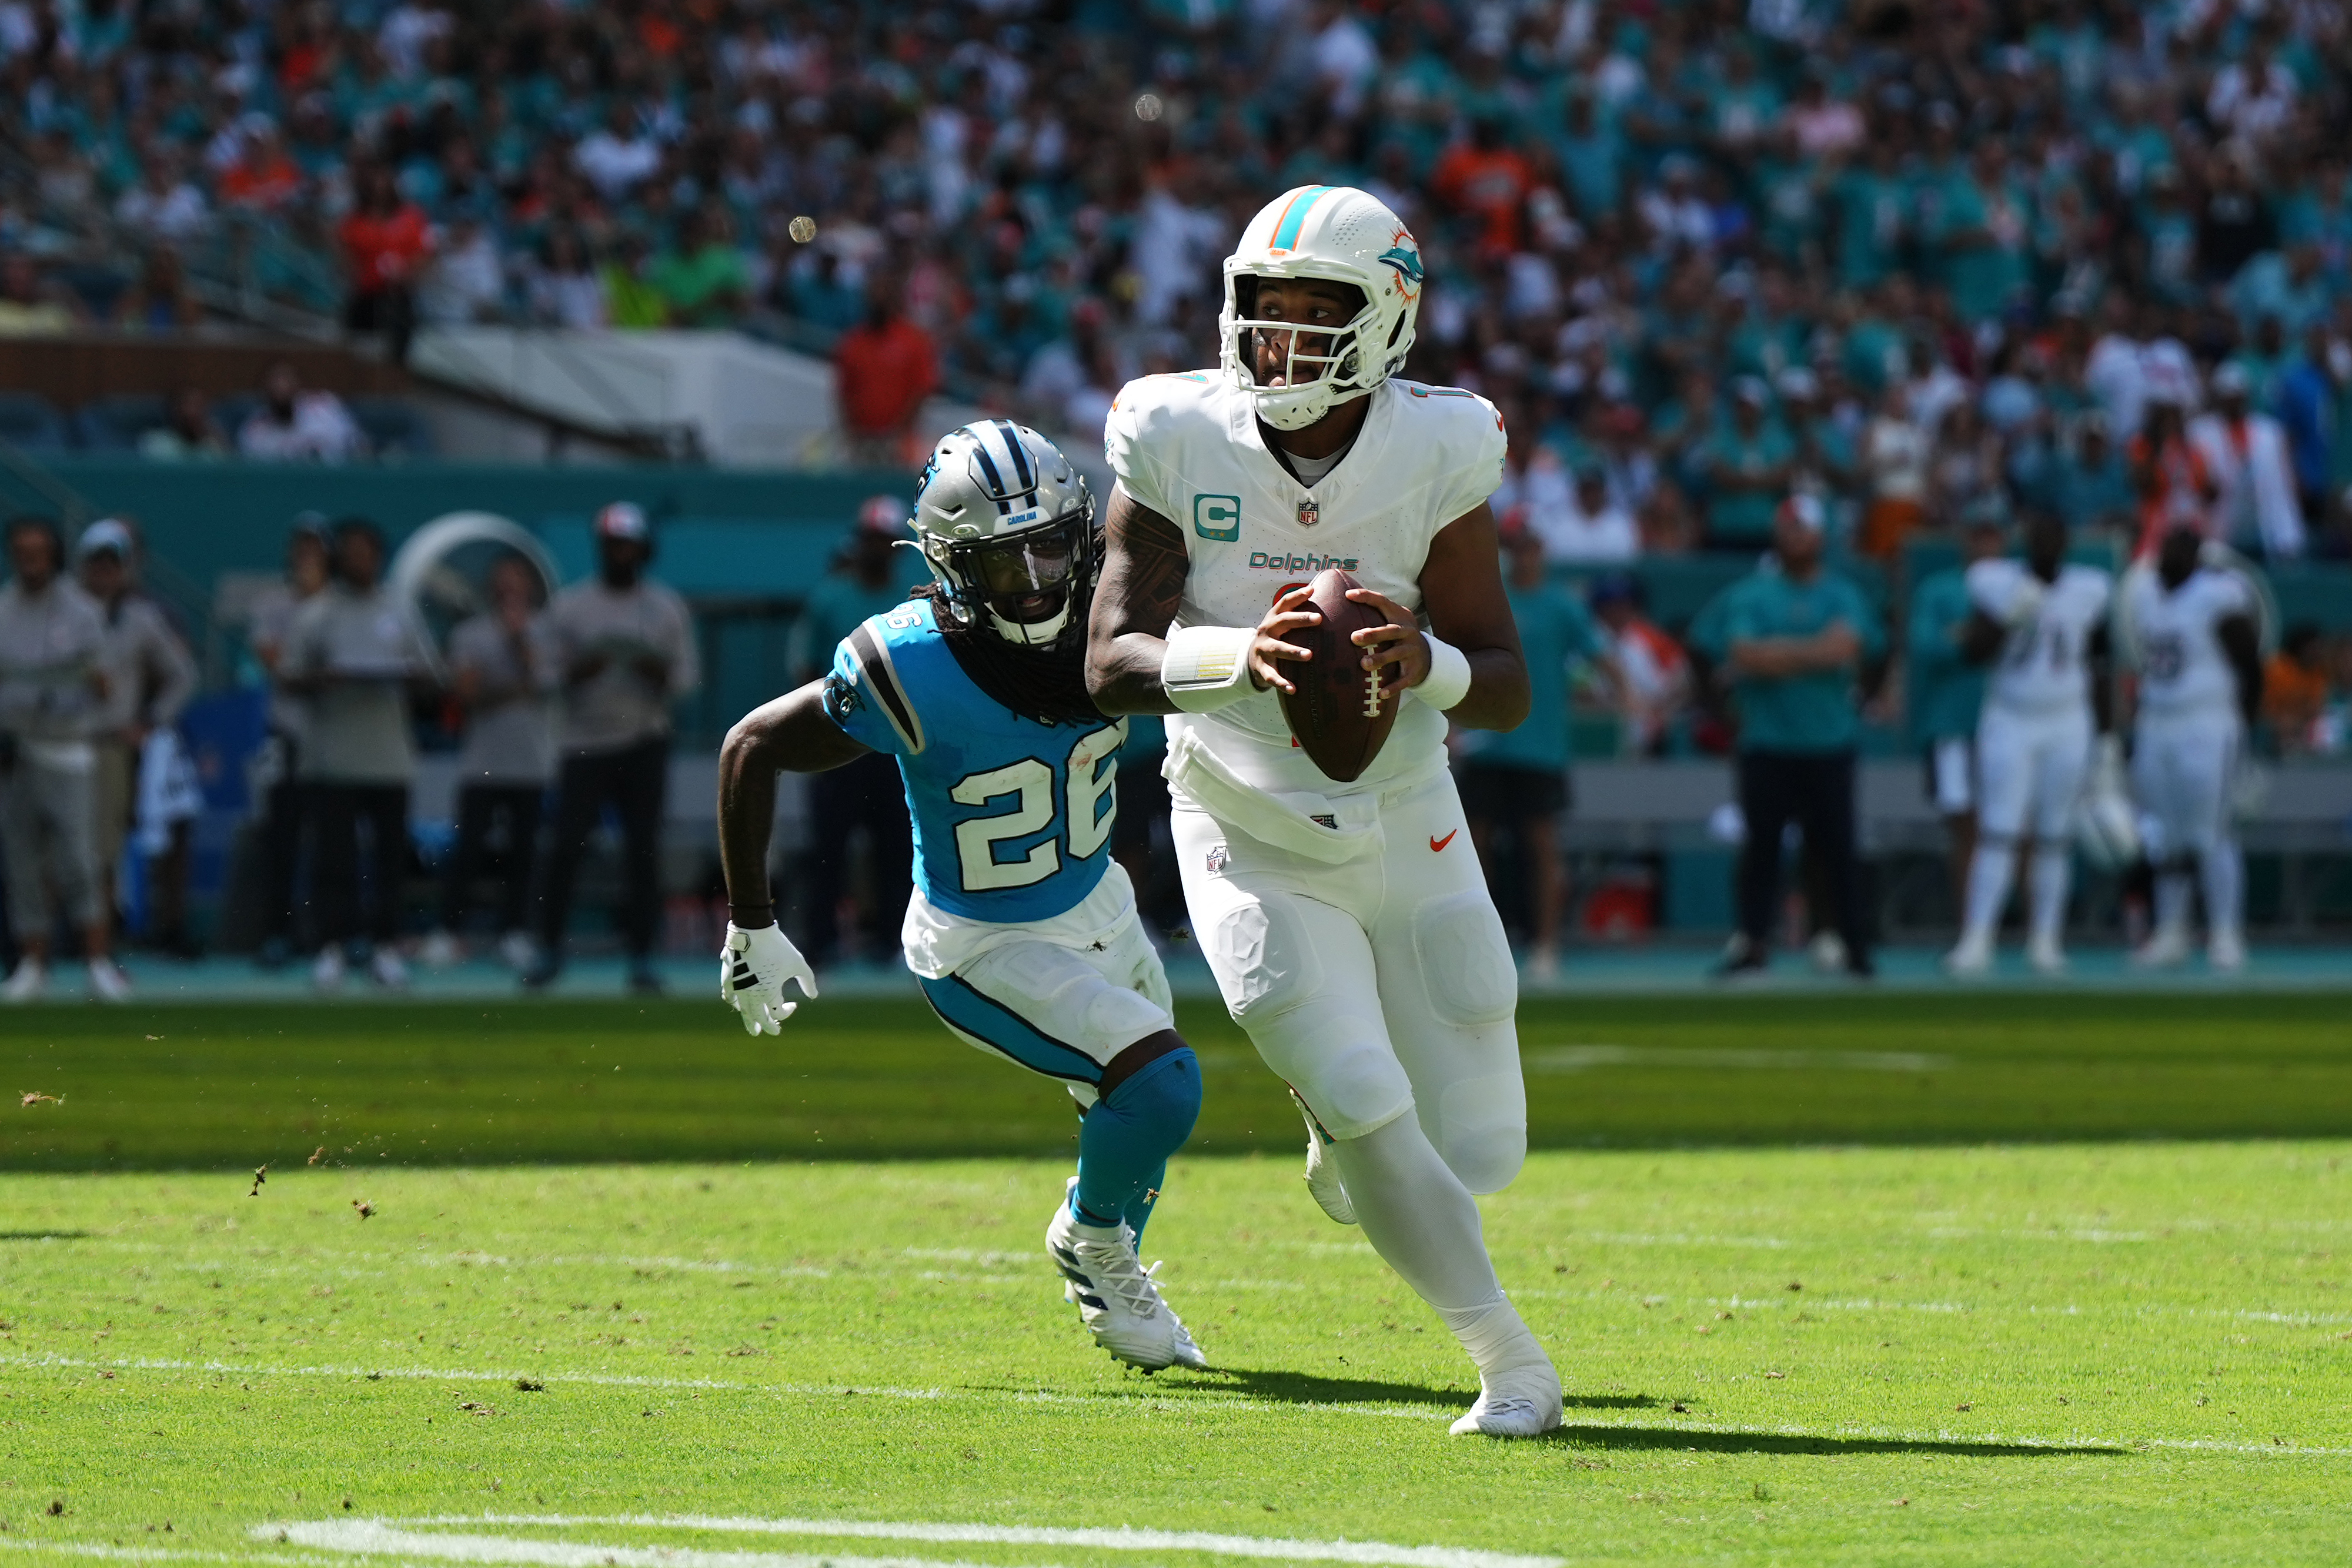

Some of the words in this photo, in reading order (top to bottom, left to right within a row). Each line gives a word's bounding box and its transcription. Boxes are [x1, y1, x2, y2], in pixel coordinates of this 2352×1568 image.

[1007, 511, 1037, 525] CAROLINA
[1197, 497, 1237, 530] C
[1300, 511, 1316, 523] NFL
[1248, 552, 1359, 575] Dolphins
[950, 714, 1128, 892] 26
[1208, 858, 1222, 870] NFL
